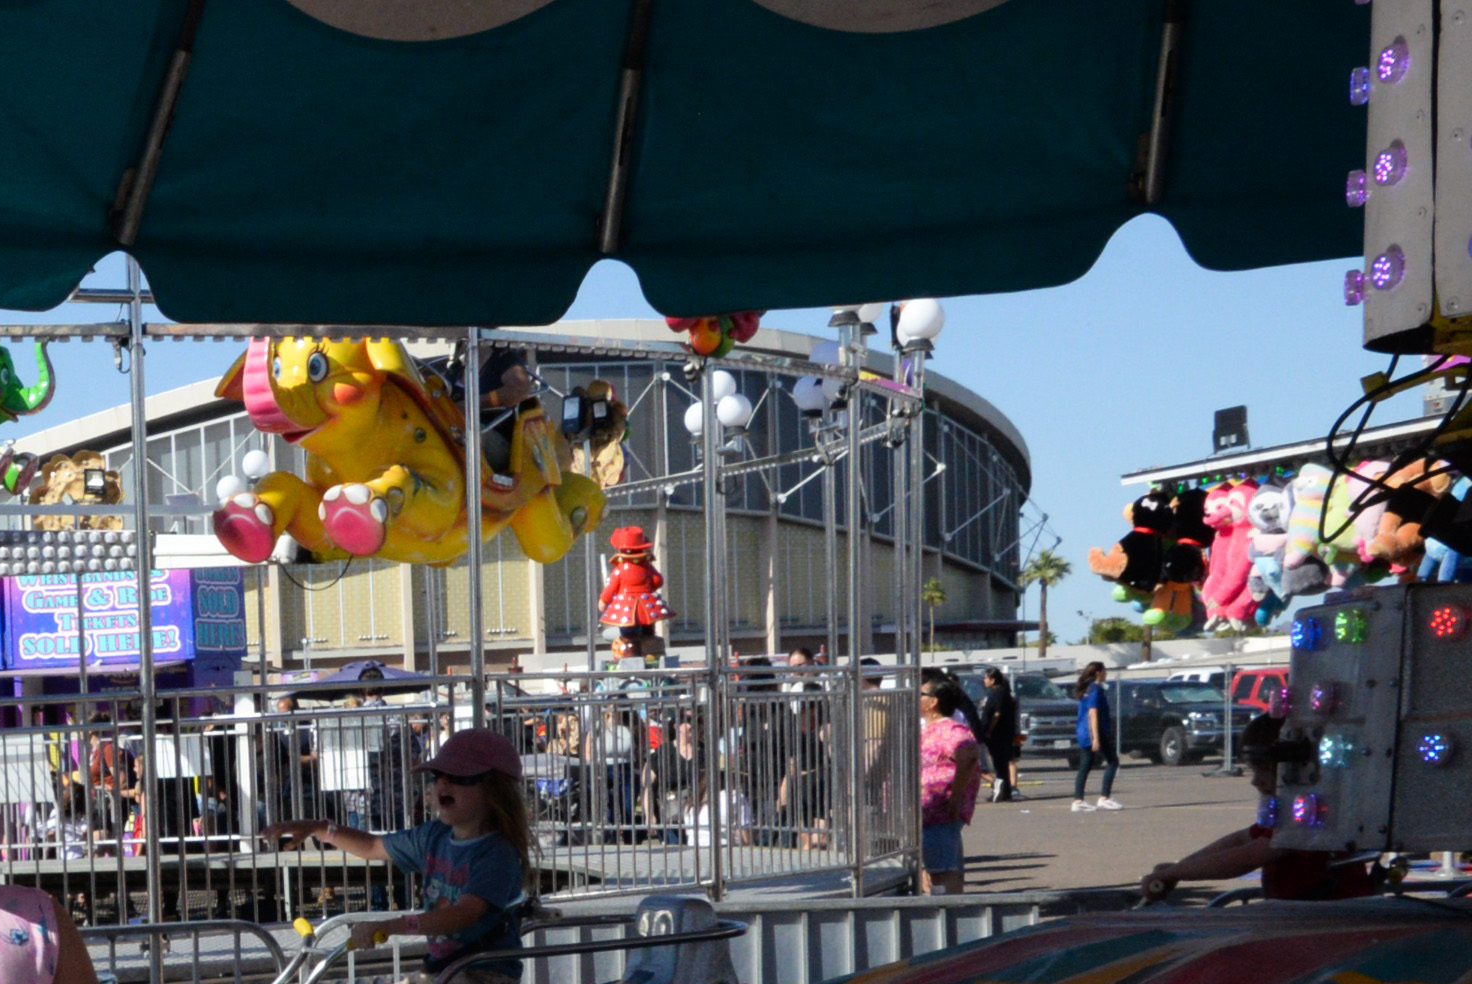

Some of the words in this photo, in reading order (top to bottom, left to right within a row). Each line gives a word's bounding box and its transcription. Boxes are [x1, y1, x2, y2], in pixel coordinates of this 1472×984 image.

[87, 587, 110, 608] &
[117, 586, 168, 606] RDE
[22, 635, 89, 656] SOLD
